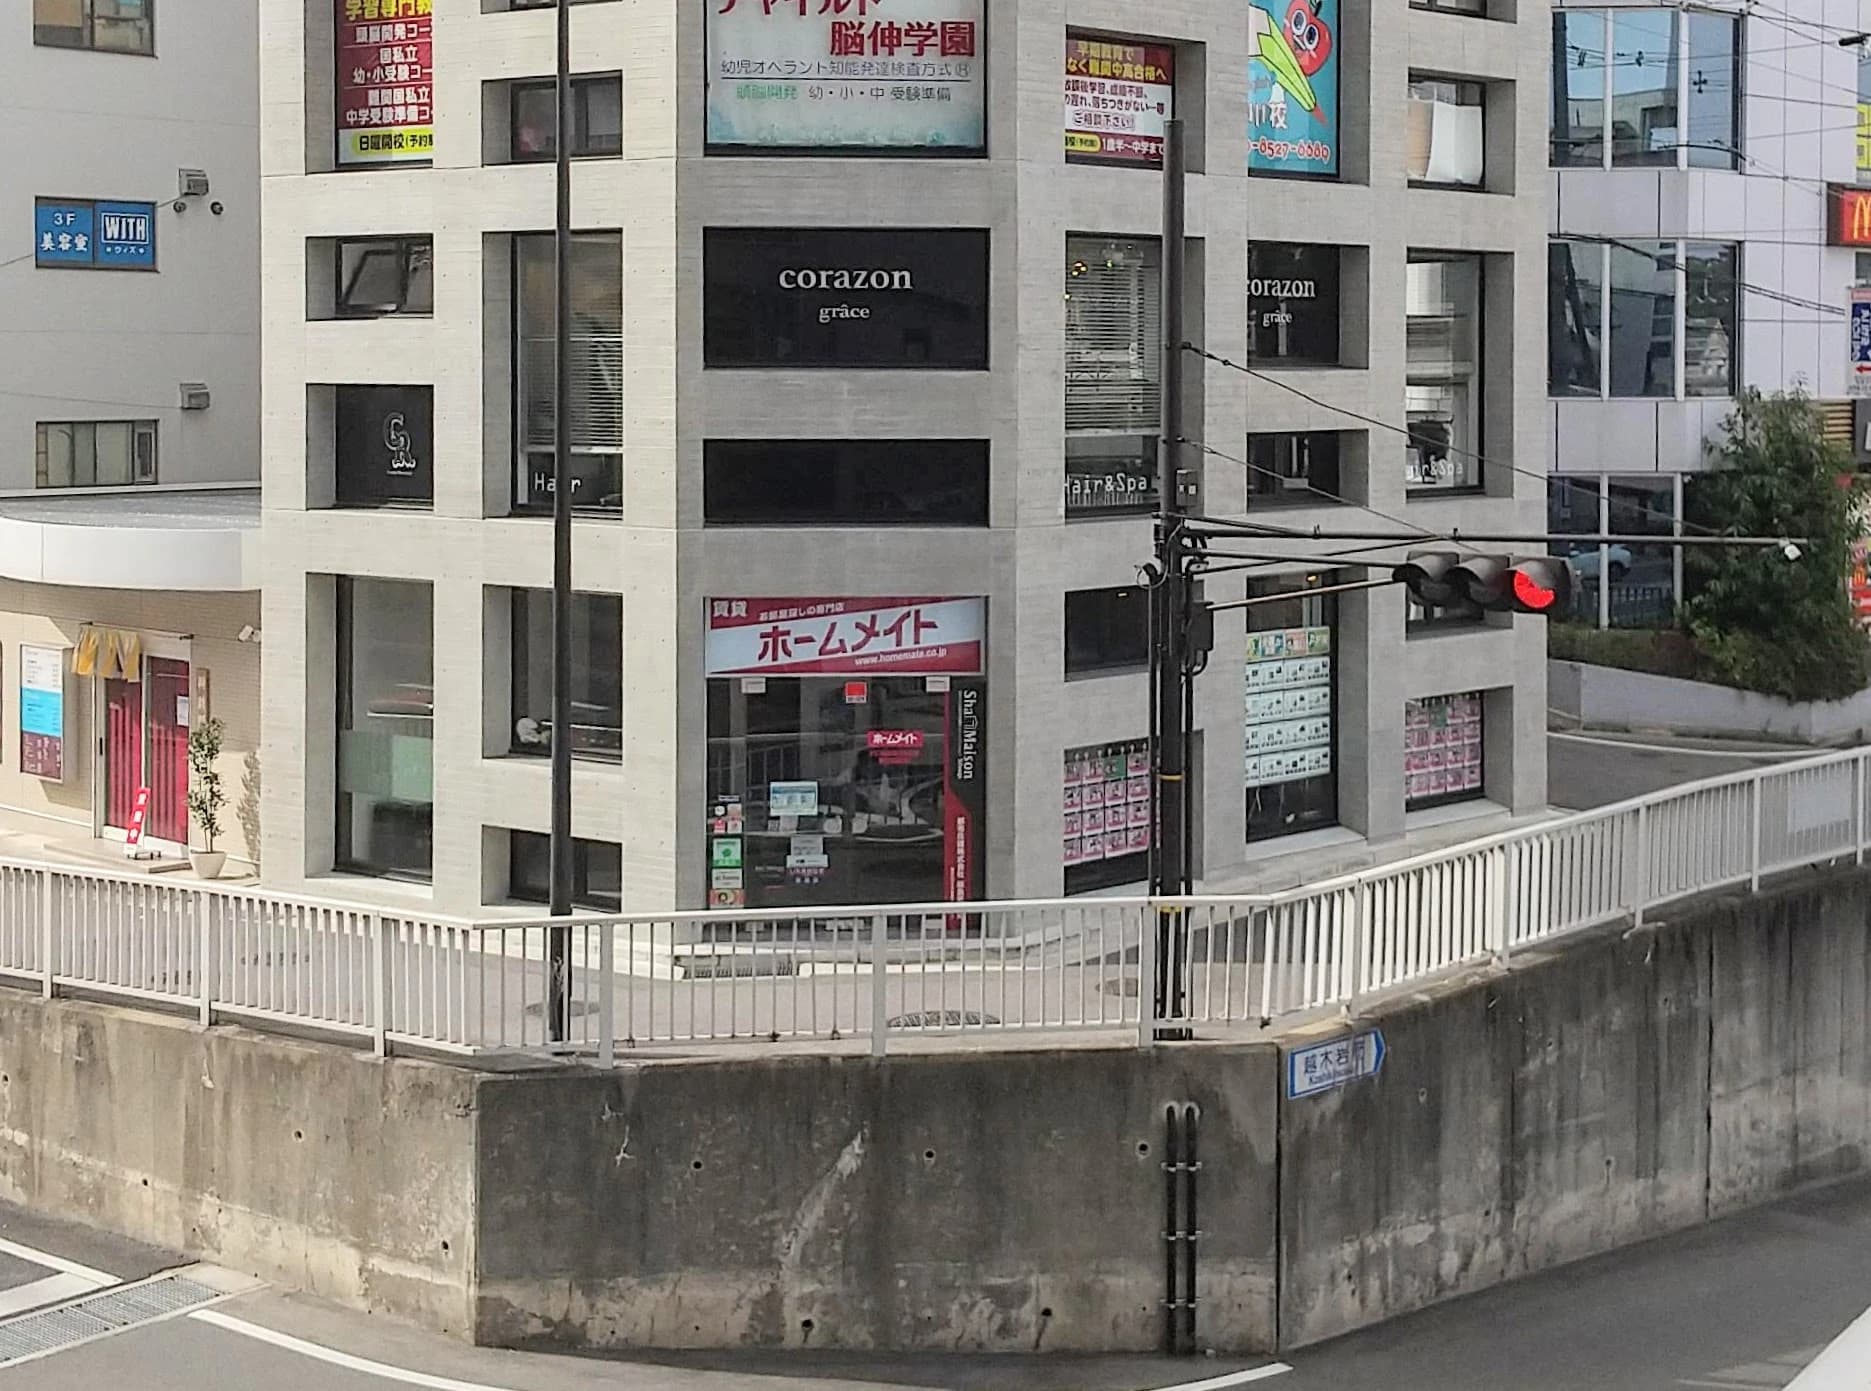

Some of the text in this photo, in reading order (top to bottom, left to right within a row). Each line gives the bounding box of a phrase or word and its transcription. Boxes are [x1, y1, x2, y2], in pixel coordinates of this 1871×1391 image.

[355, 22, 432, 43] 頭脳開発コー
[830, 20, 975, 57] 脳伸学園
[890, 85, 951, 102] 受験準備
[346, 107, 432, 125] 中学受験準備コ
[54, 212, 76, 226] 3F
[105, 216, 146, 240] WITH
[41, 231, 88, 251] 美容室
[779, 268, 914, 290] corazon
[818, 304, 870, 323] grâce
[534, 472, 581, 493] Har
[713, 599, 748, 618] 賃貸
[758, 609, 938, 662] ホームメイト
